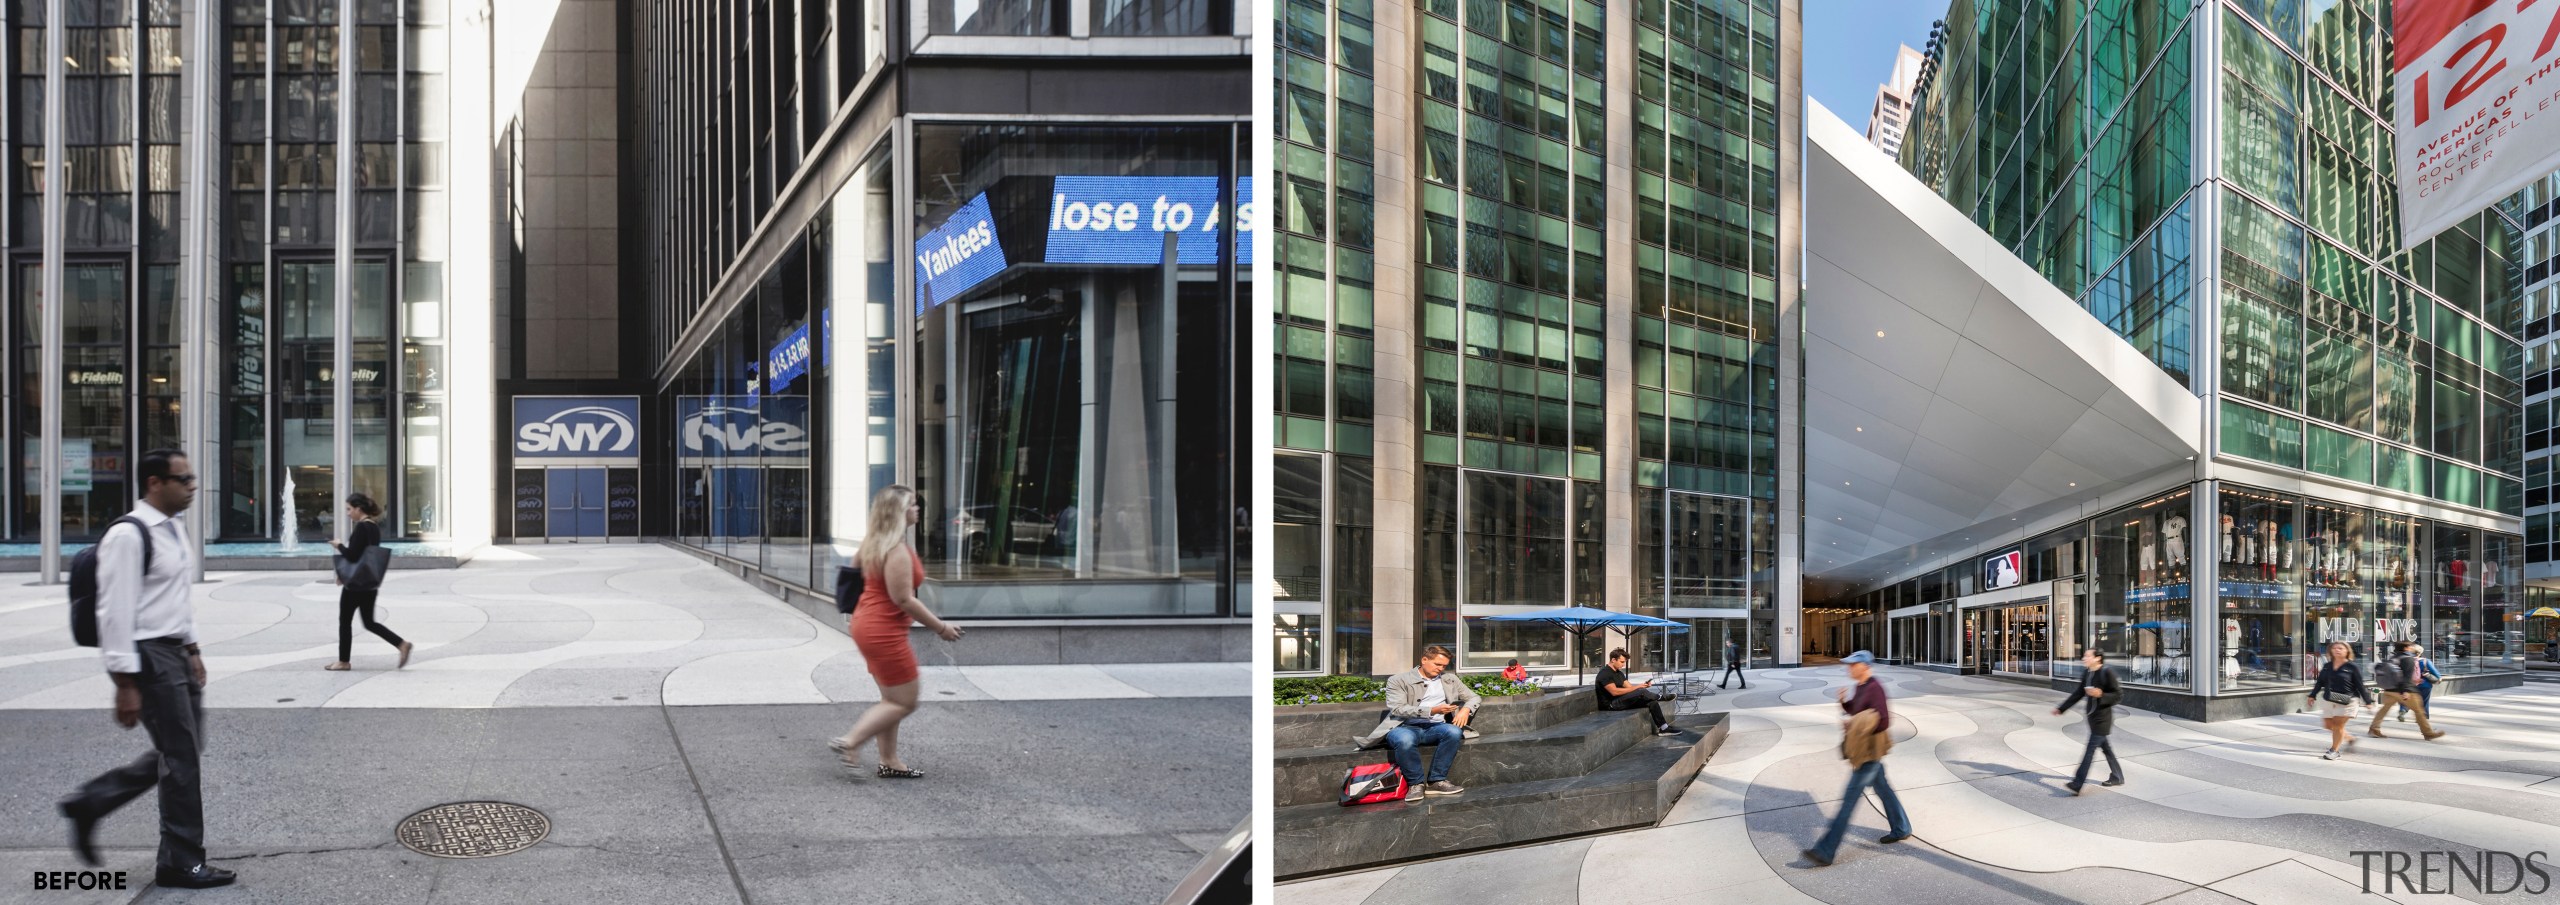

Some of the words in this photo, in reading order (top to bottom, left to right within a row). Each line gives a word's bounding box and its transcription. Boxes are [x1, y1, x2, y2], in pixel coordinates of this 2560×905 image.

[2414, 0, 2560, 128] 127
[2417, 108, 2487, 158] AVENUE
[2494, 86, 2518, 107] OF
[2417, 107, 2512, 172] AMERICAS
[2420, 150, 2493, 198] CENTER
[1052, 193, 1138, 232] lose
[1152, 195, 1193, 232] to
[918, 218, 991, 280] Yankees
[241, 315, 263, 417] Fideliy
[517, 420, 619, 452] SNY
[517, 499, 540, 508] SNY
[610, 499, 633, 508] SNY
[2319, 616, 2360, 643] MLB
[2385, 618, 2418, 642] NYC
